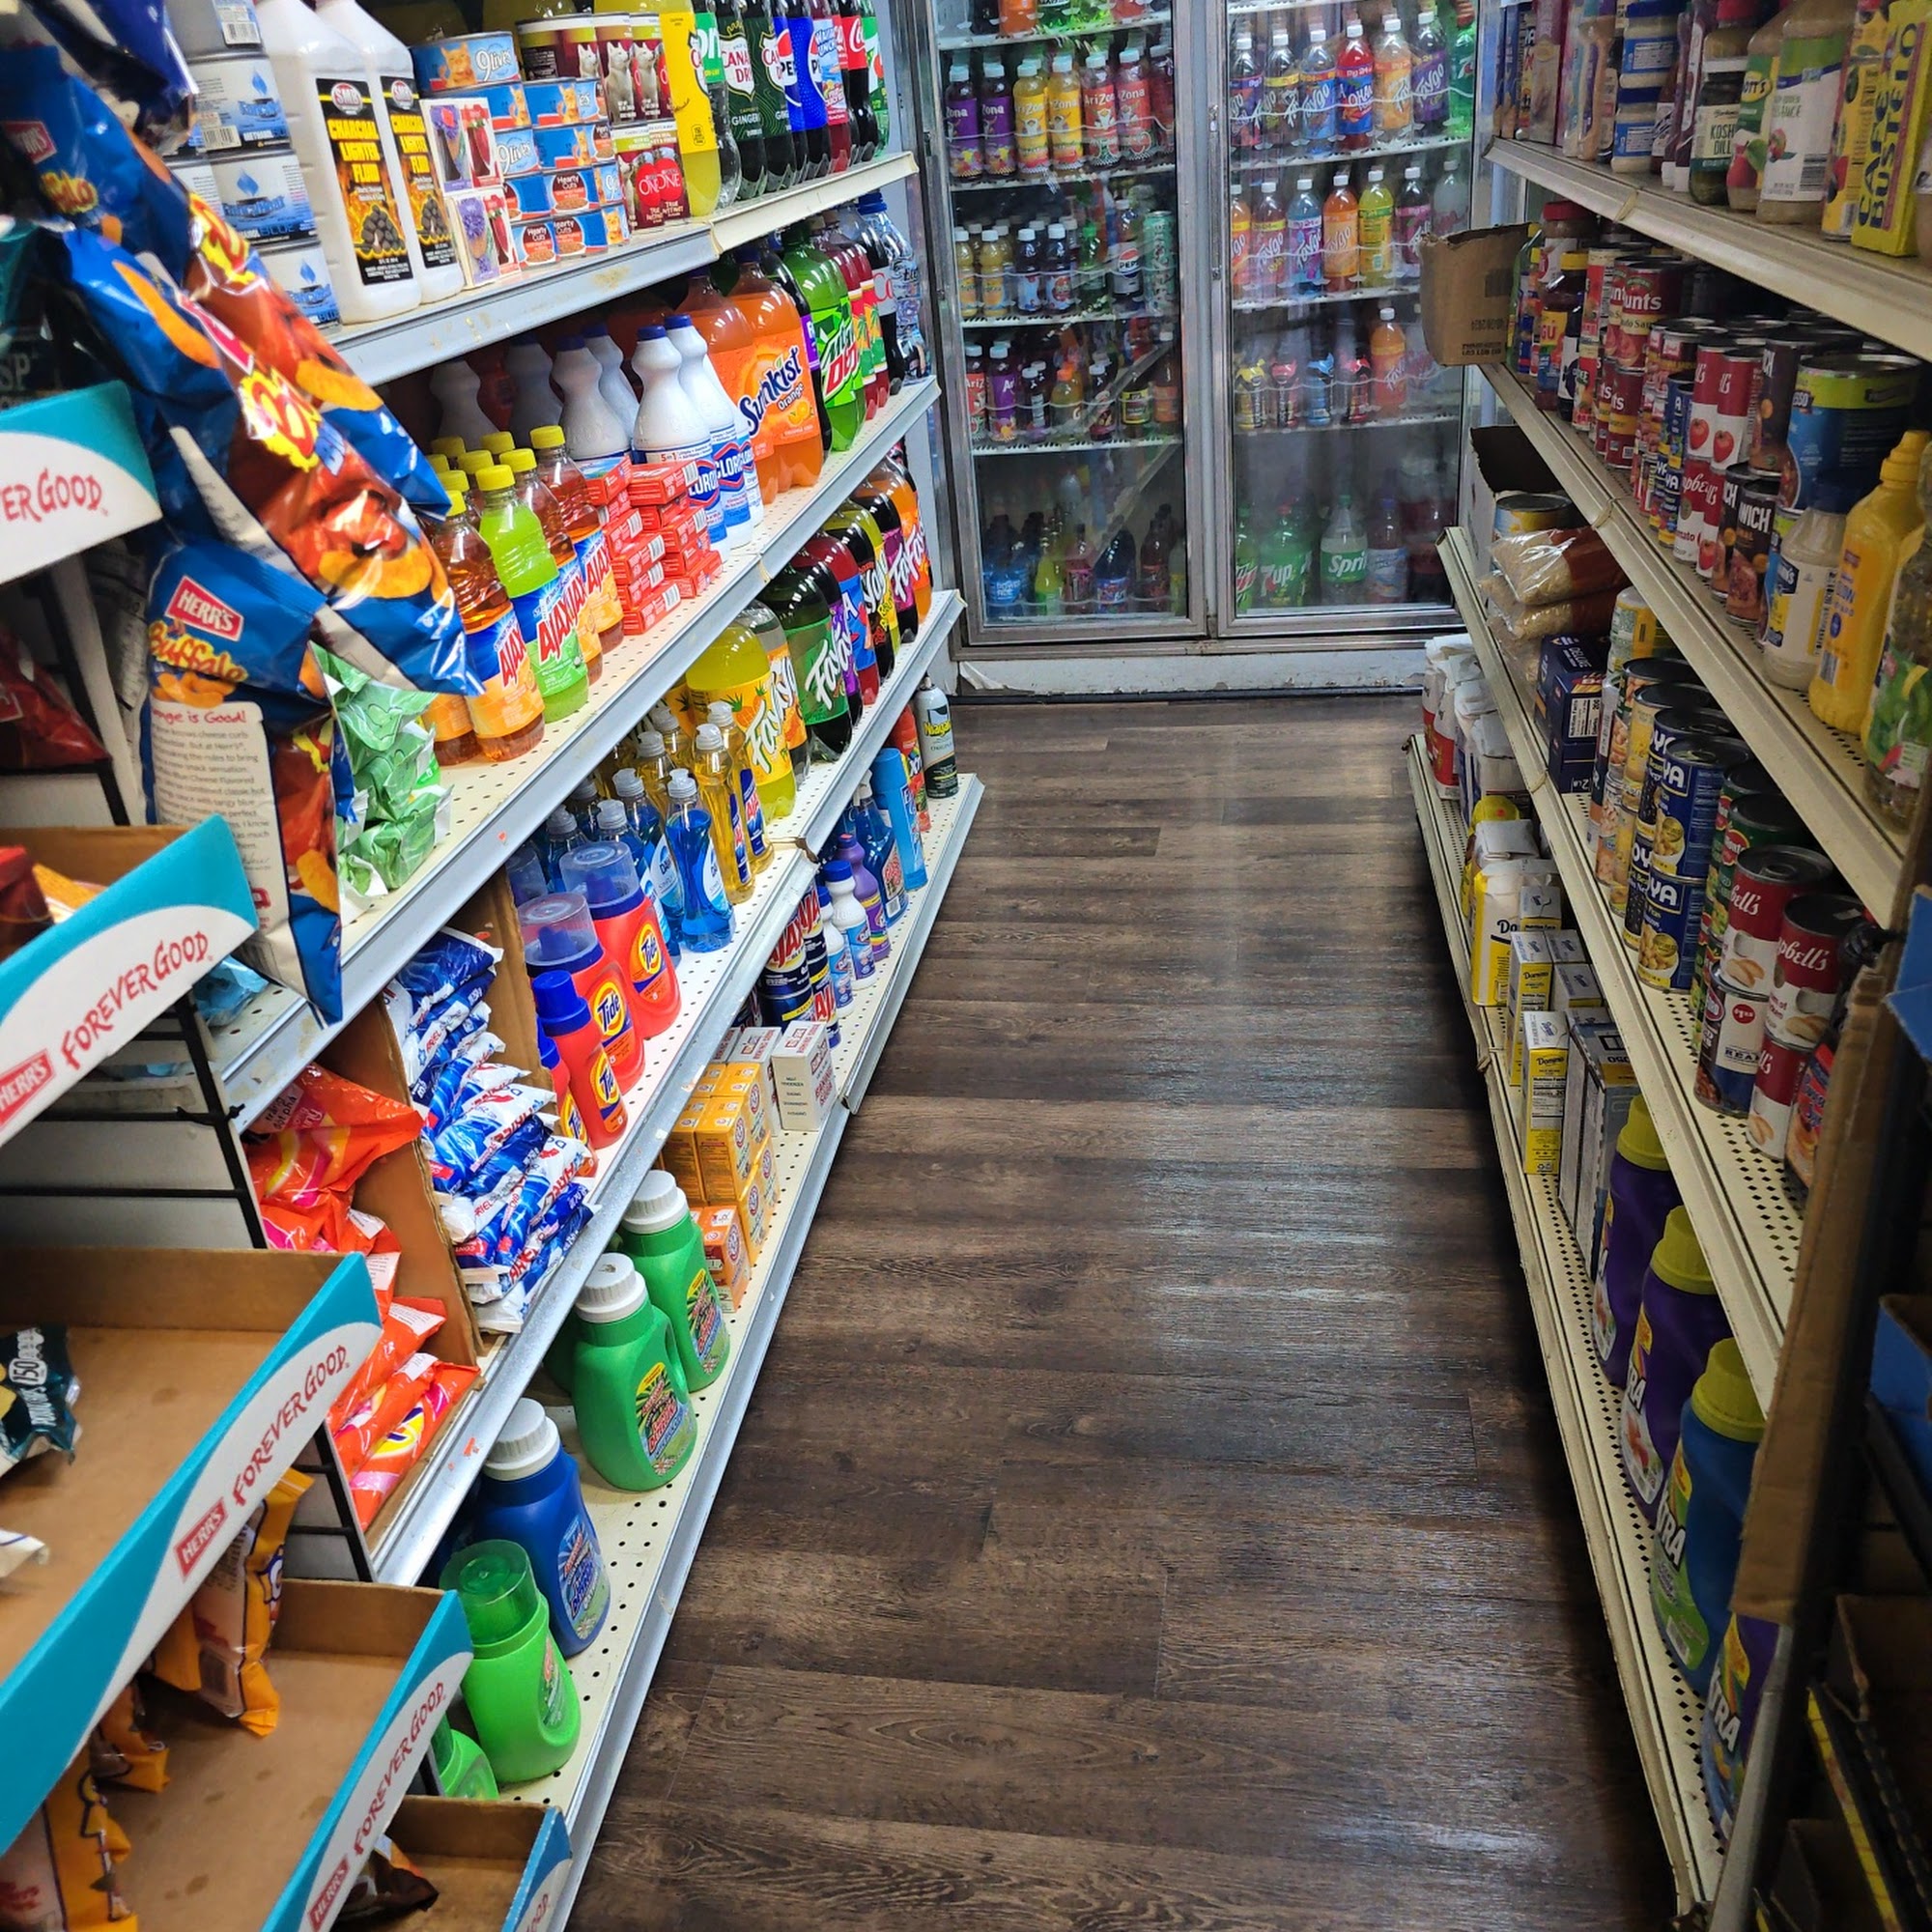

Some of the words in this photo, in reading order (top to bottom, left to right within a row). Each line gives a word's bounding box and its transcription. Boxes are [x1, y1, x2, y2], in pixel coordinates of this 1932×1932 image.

[723, 51, 750, 69] CANA
[735, 67, 754, 84] DR
[1120, 87, 1146, 101] Zona
[946, 104, 968, 118] Zona
[981, 103, 1005, 116] Zona
[327, 119, 380, 140] CHARCOAL
[1711, 124, 1735, 140] KOSH
[1870, 23, 1918, 228] BUSTELO
[339, 141, 381, 162] LIGHTER
[352, 163, 381, 183] FLUID
[738, 344, 803, 438] Sunkist
[777, 383, 805, 411] Orange
[38, 468, 102, 513] GOOD
[1739, 502, 1772, 533] WICH
[585, 544, 612, 595] AJAX
[1328, 552, 1367, 578] Spri
[178, 590, 236, 634] HERR'S
[498, 628, 527, 688] AJAX
[187, 710, 199, 724] is
[204, 710, 247, 724] Good!
[1777, 936, 1830, 972] pbell's
[61, 962, 158, 1071] FOREVER
[154, 930, 209, 980] GOOD
[597, 990, 621, 1032] Tide
[1724, 1047, 1760, 1062] REA
[13, 1360, 40, 1382] 150
[232, 1391, 307, 1507] FOREVER
[304, 1344, 347, 1400] GOOD
[354, 1739, 412, 1857] FOREVER
[410, 1682, 444, 1744] GOOD
